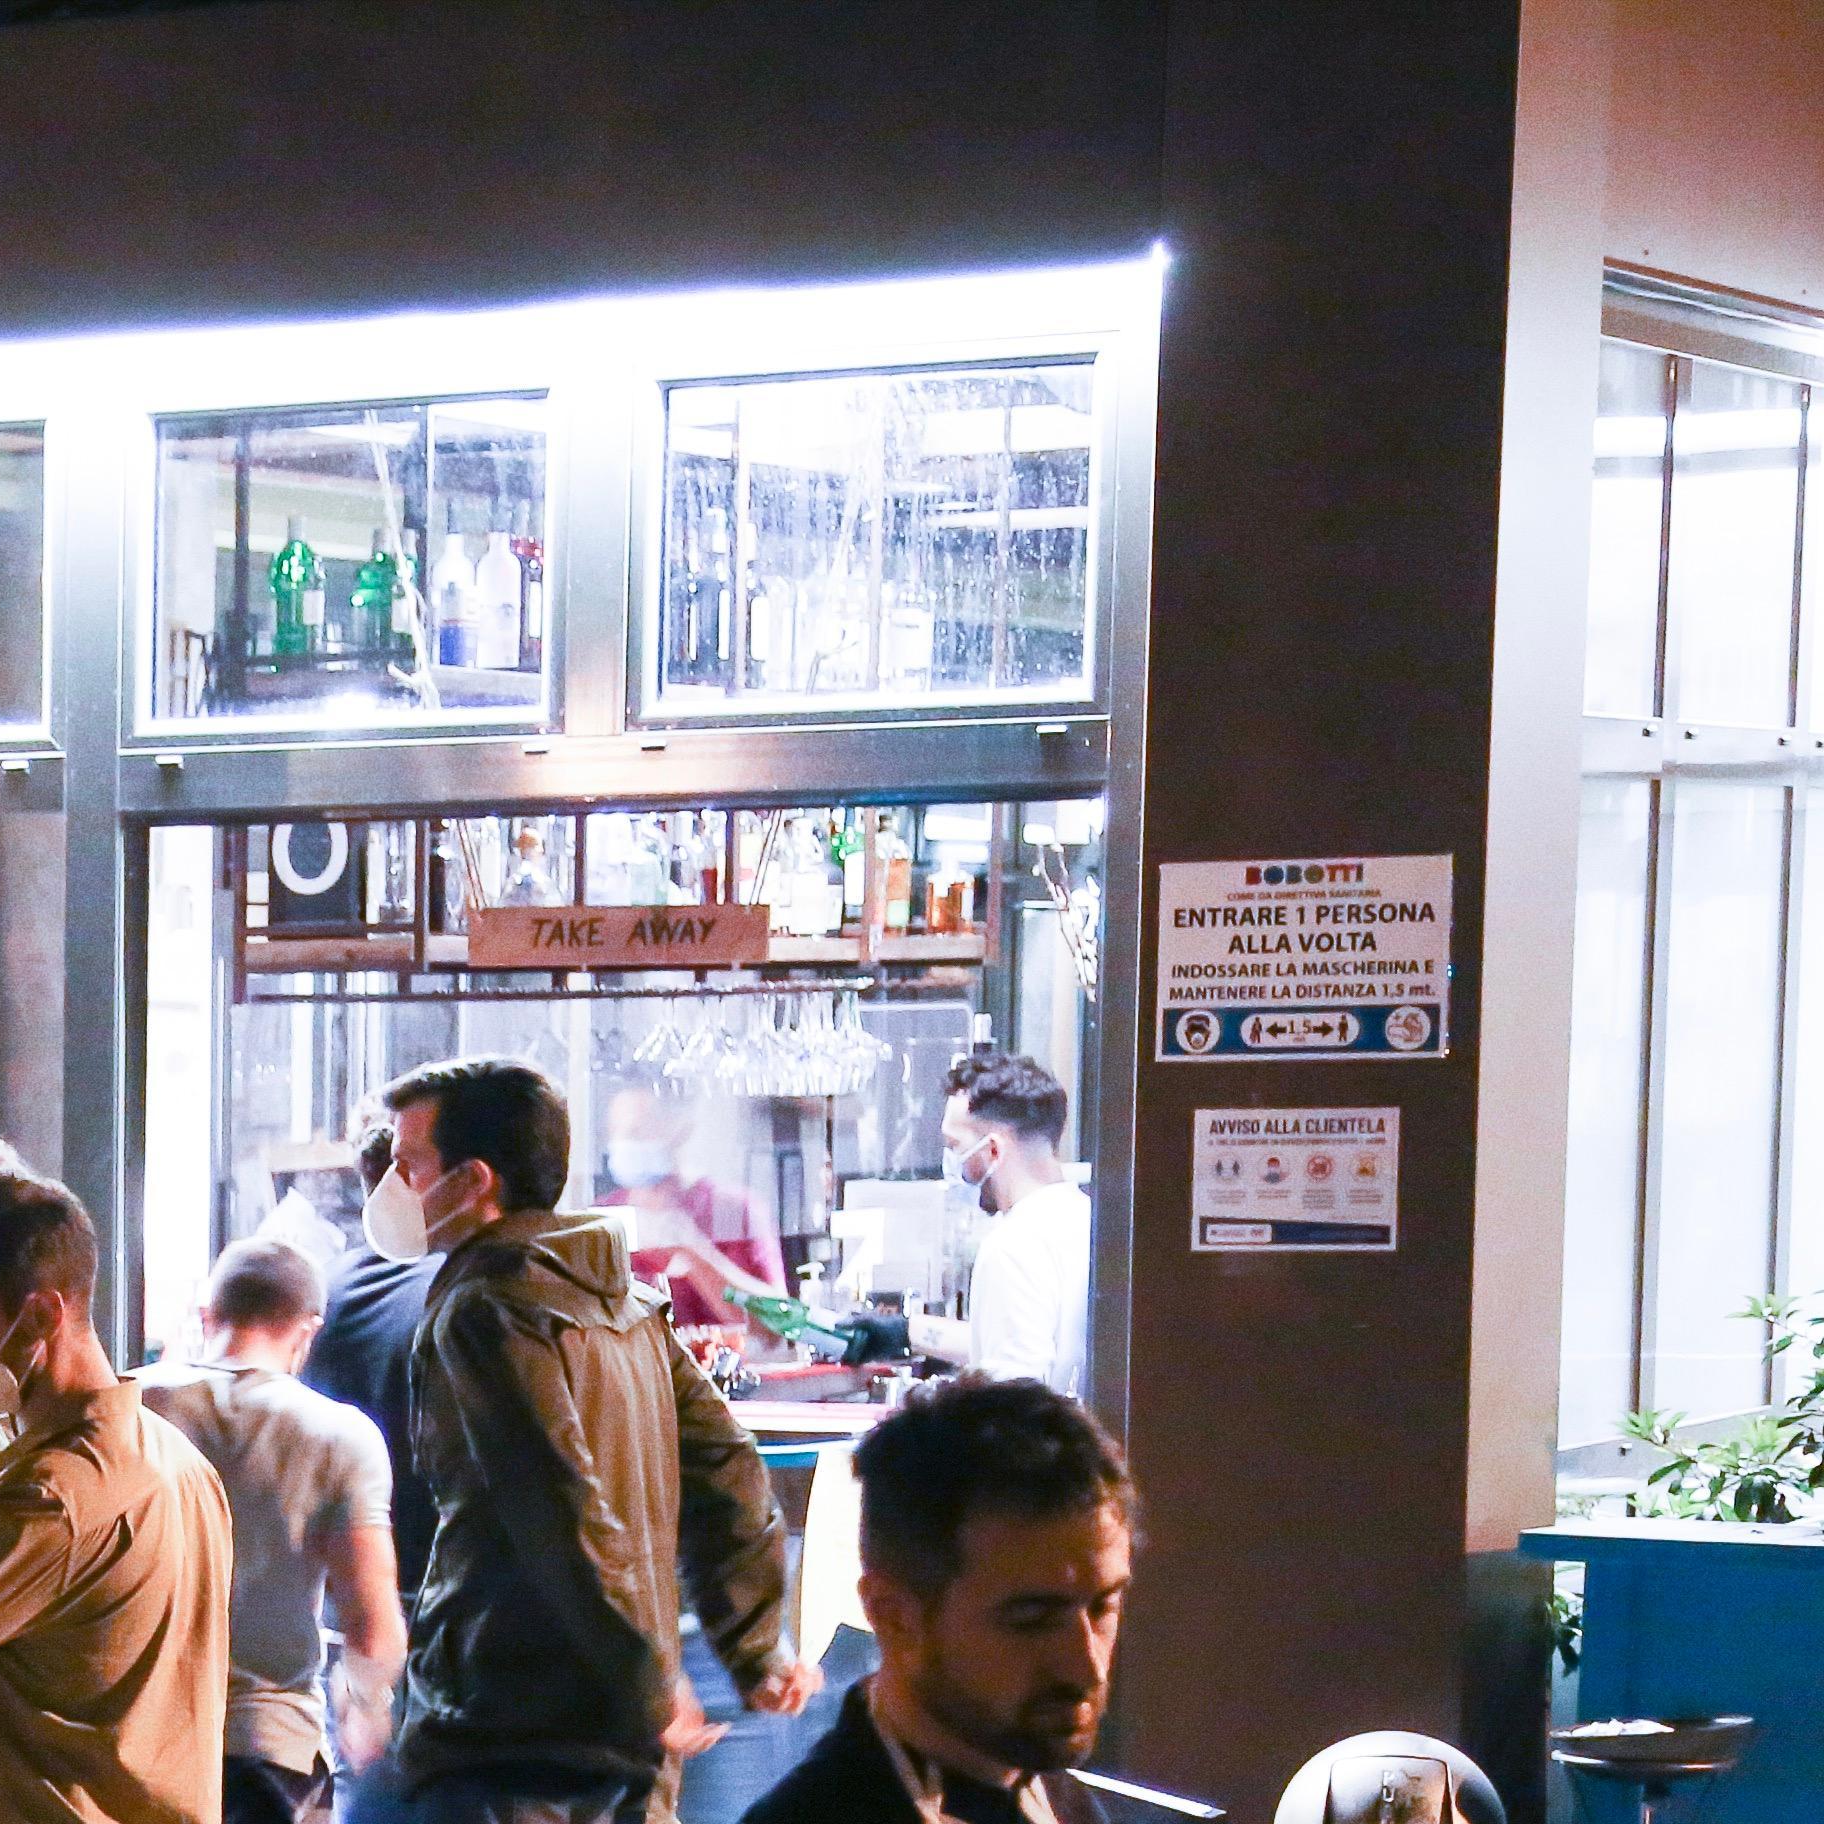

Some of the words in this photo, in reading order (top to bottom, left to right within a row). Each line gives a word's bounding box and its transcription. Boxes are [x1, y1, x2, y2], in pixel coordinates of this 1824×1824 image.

[1245, 864, 1363, 885] BOBOTTI
[1174, 906, 1287, 928] ENTRARE
[1296, 906, 1306, 926] 1
[1316, 903, 1435, 925] PERSONA
[529, 918, 606, 948] TAKE
[627, 914, 718, 945] AWAY
[1228, 933, 1292, 954] ALLA
[1299, 931, 1377, 952] VOLTA
[1171, 963, 1270, 978] INDOSSARE
[1275, 961, 1297, 976] LA
[1302, 961, 1420, 976] MASCHERINA
[1425, 960, 1435, 974] E
[1169, 985, 1267, 1000] MANTENERE
[1271, 985, 1291, 999] LA
[1296, 984, 1376, 998] DISTANZA
[1209, 1119, 1260, 1135] AVVISO
[1264, 1118, 1300, 1135] ALLA
[1305, 1118, 1385, 1134] CLIENTELA
